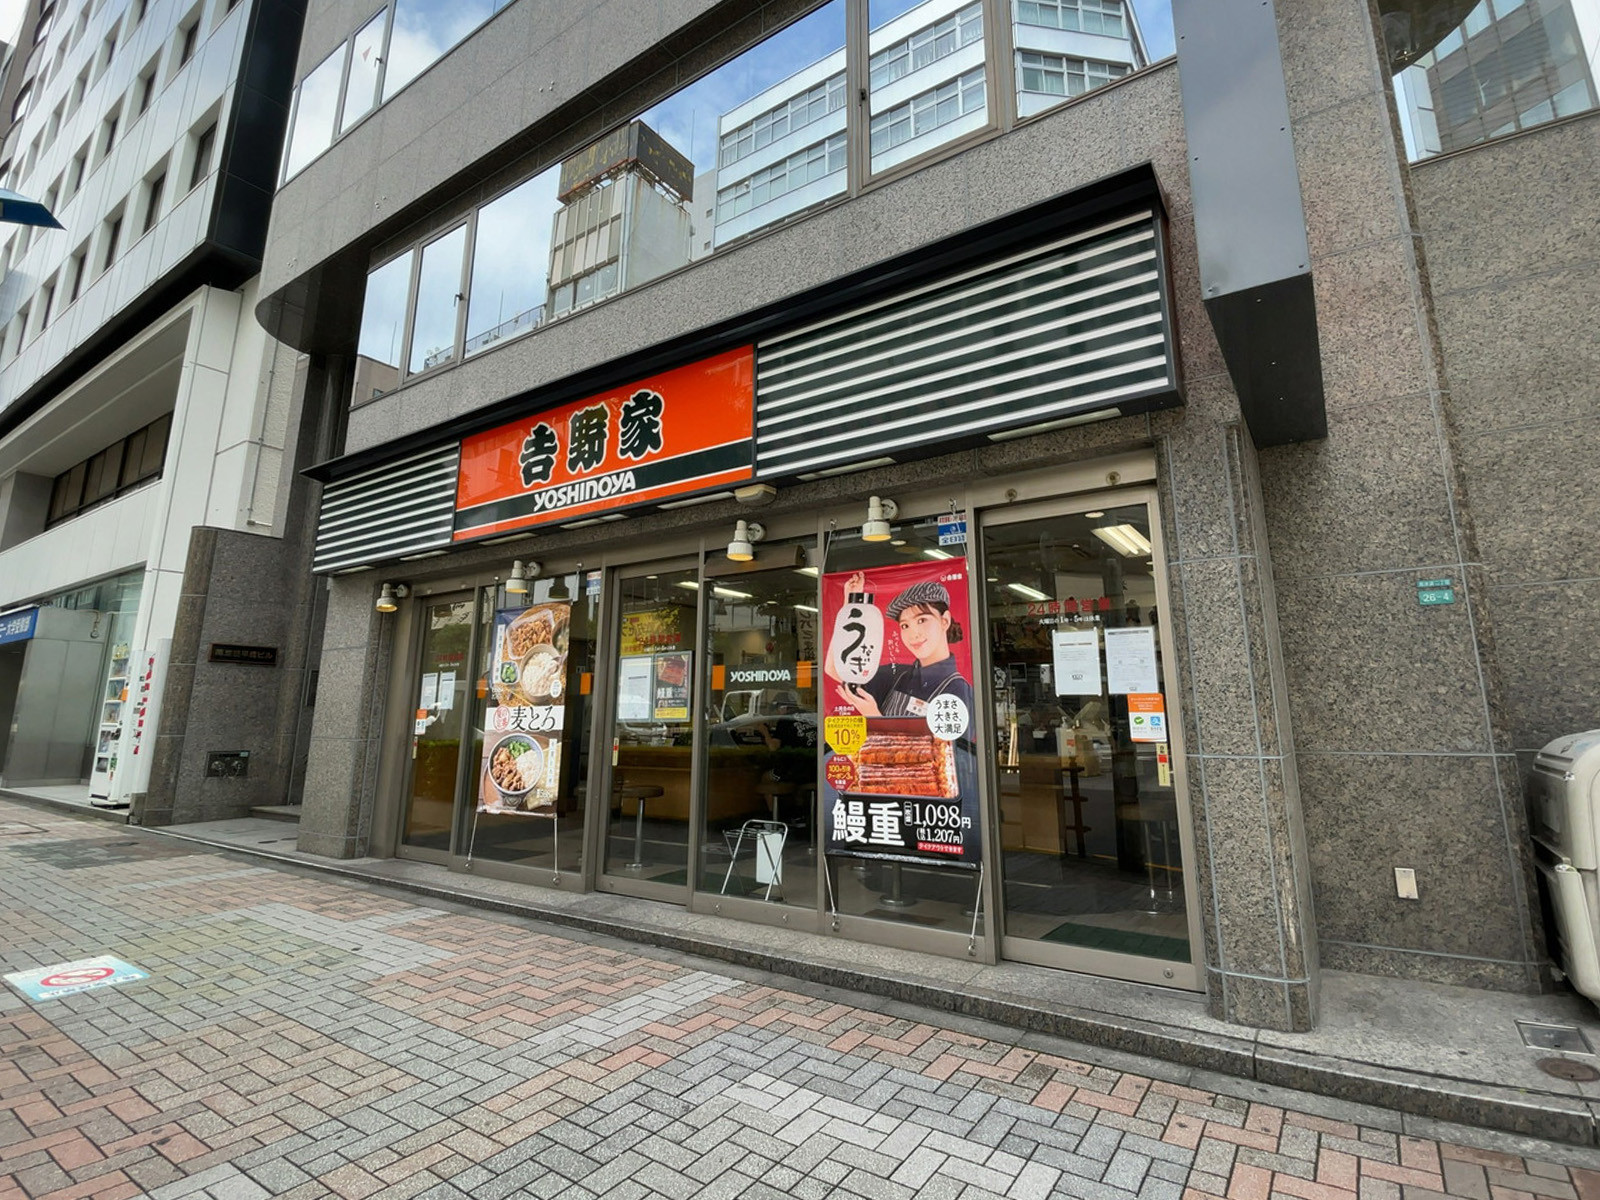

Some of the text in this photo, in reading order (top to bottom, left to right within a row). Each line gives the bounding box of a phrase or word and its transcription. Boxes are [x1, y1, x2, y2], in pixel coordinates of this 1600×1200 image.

[533, 470, 637, 512] YOSHINOYA
[730, 669, 791, 682] YOSHINOYA
[935, 699, 958, 709] うまさ
[510, 705, 556, 731] 麦とろ
[934, 723, 962, 734] 大満足
[834, 728, 860, 746] 10%
[832, 799, 905, 847] 鰻重
[913, 803, 972, 829] 1,098円
